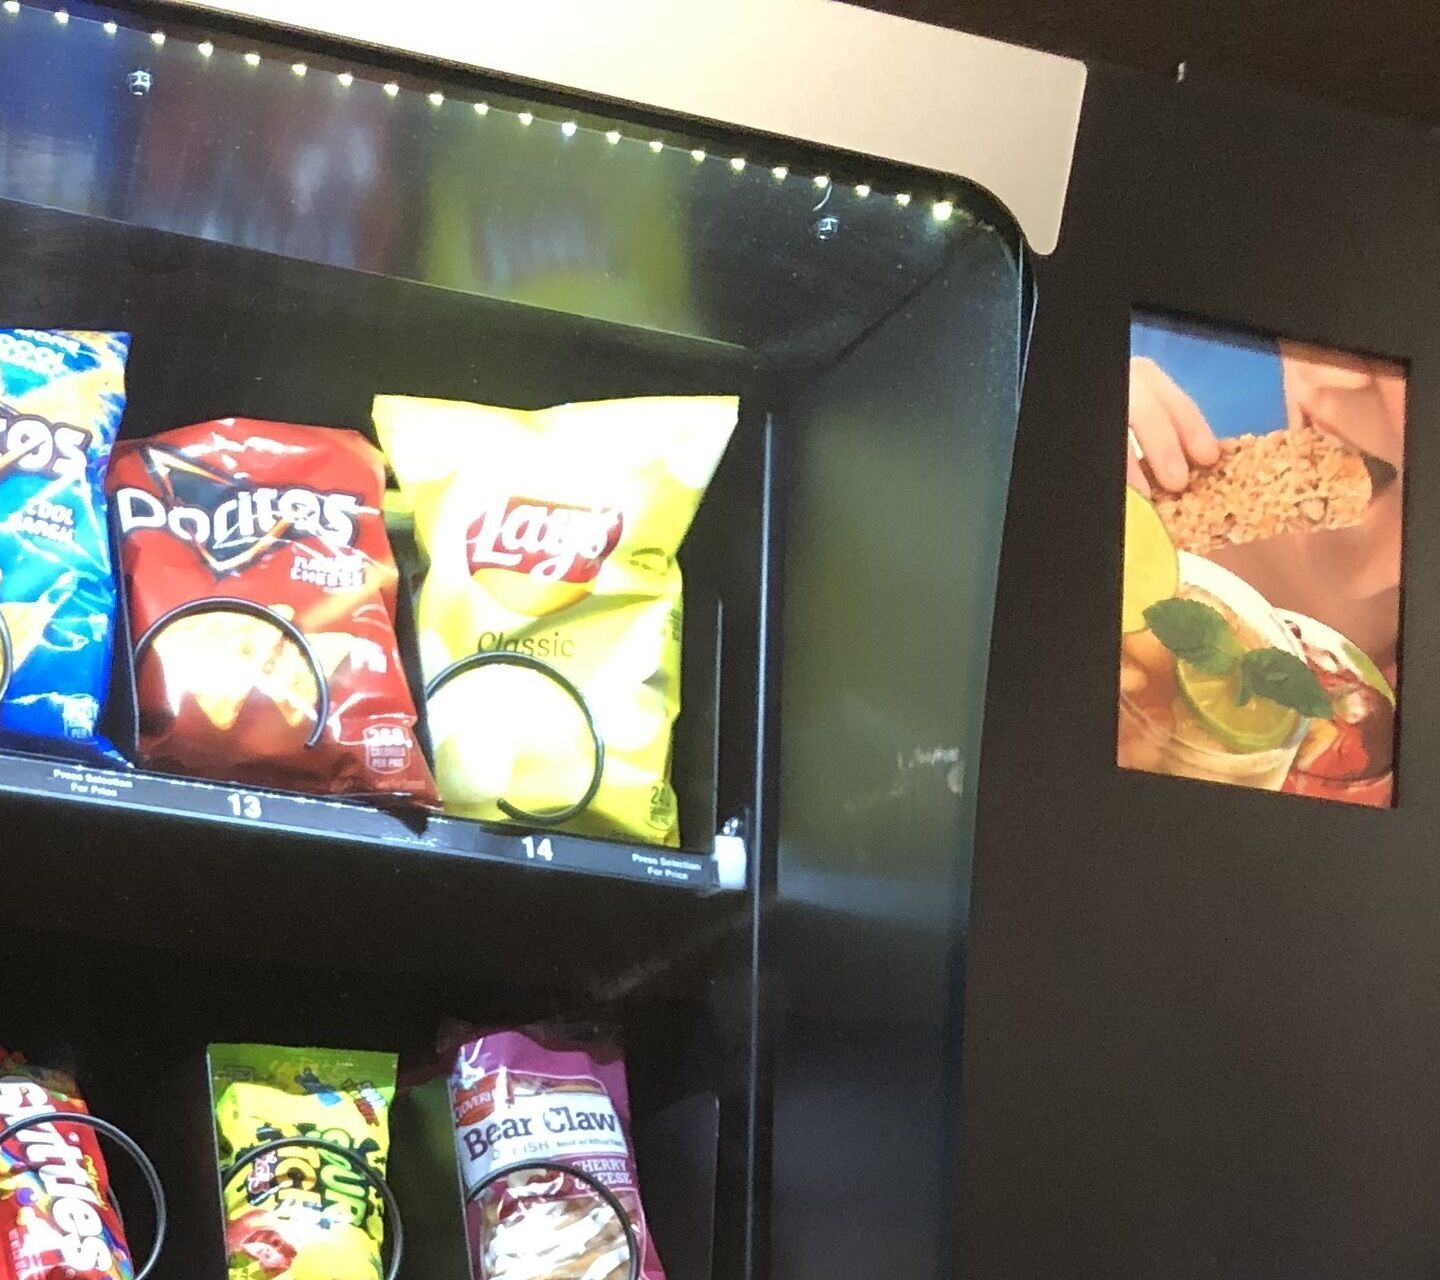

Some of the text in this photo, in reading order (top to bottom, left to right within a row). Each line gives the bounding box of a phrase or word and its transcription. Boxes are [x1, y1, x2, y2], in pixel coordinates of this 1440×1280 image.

[115, 484, 360, 549] Doritos
[477, 631, 577, 659] Classic
[228, 793, 263, 819] 13
[521, 836, 553, 862] 14
[463, 1106, 617, 1161] Bear Claw
